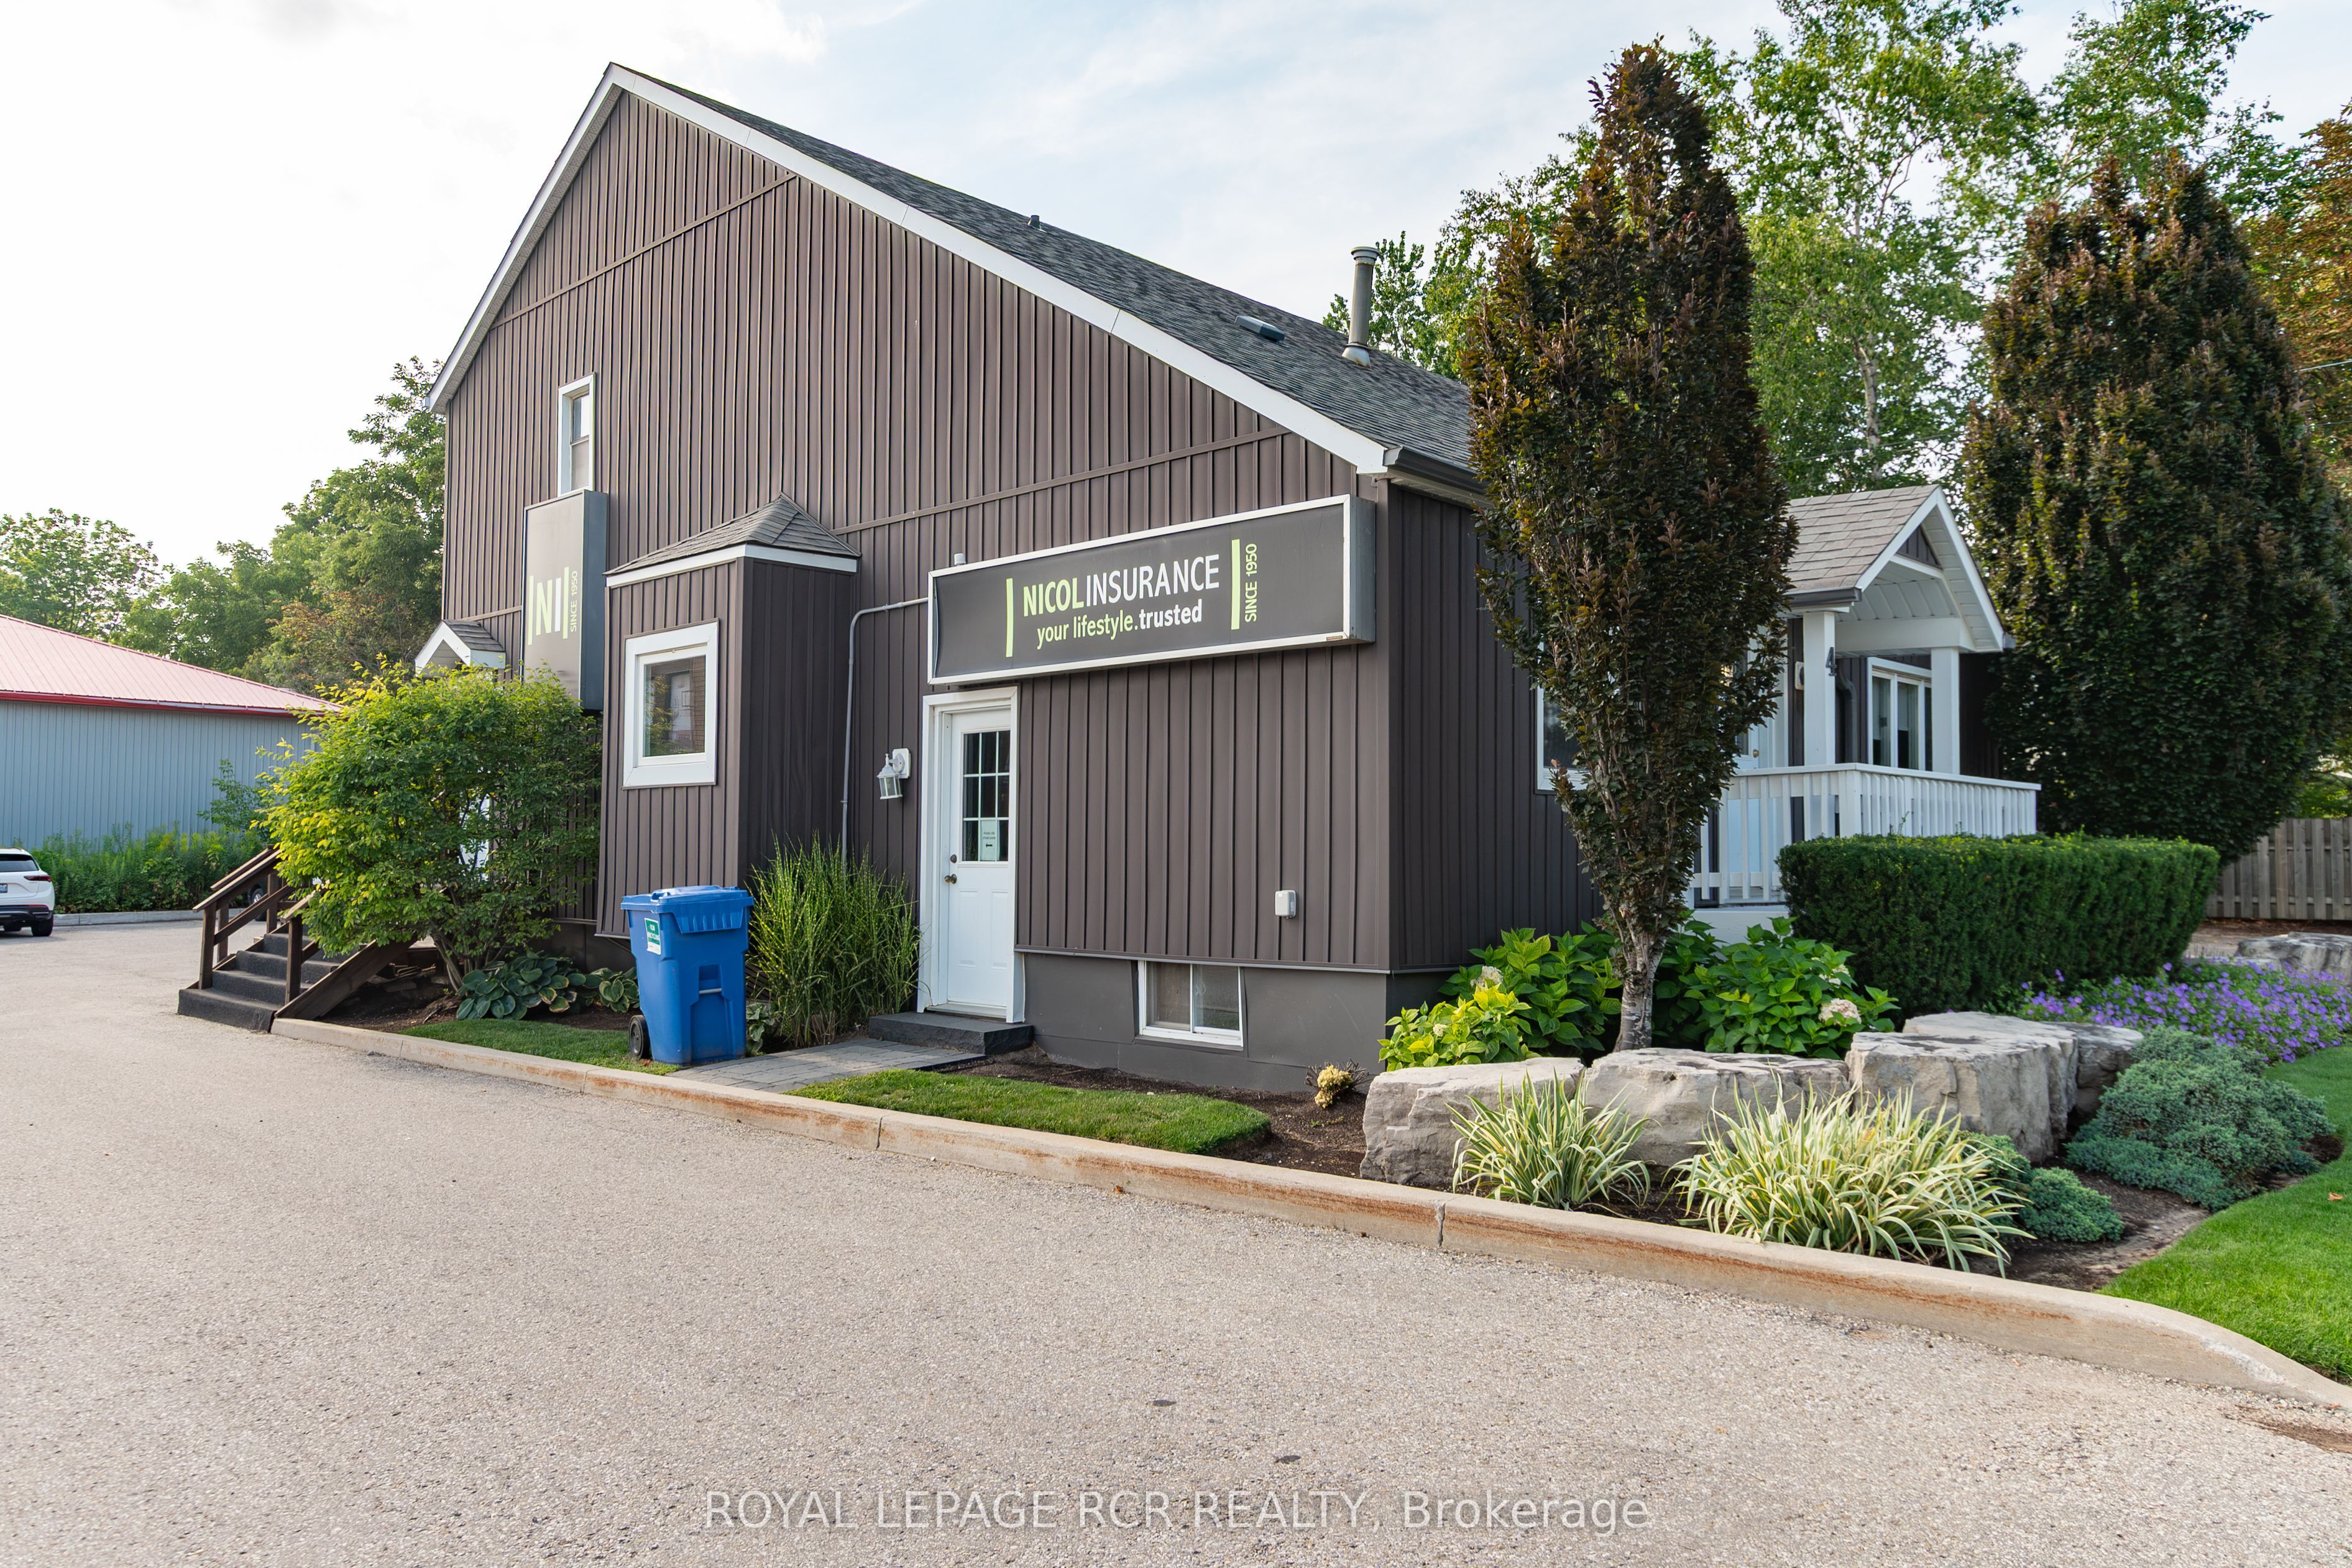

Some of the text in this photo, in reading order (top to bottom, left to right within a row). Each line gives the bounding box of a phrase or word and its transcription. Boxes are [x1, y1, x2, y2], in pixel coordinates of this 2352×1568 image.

[1244, 543, 1257, 623] SINCE 1950
[1037, 623, 1069, 650] your
[1826, 646, 1837, 676] 4
